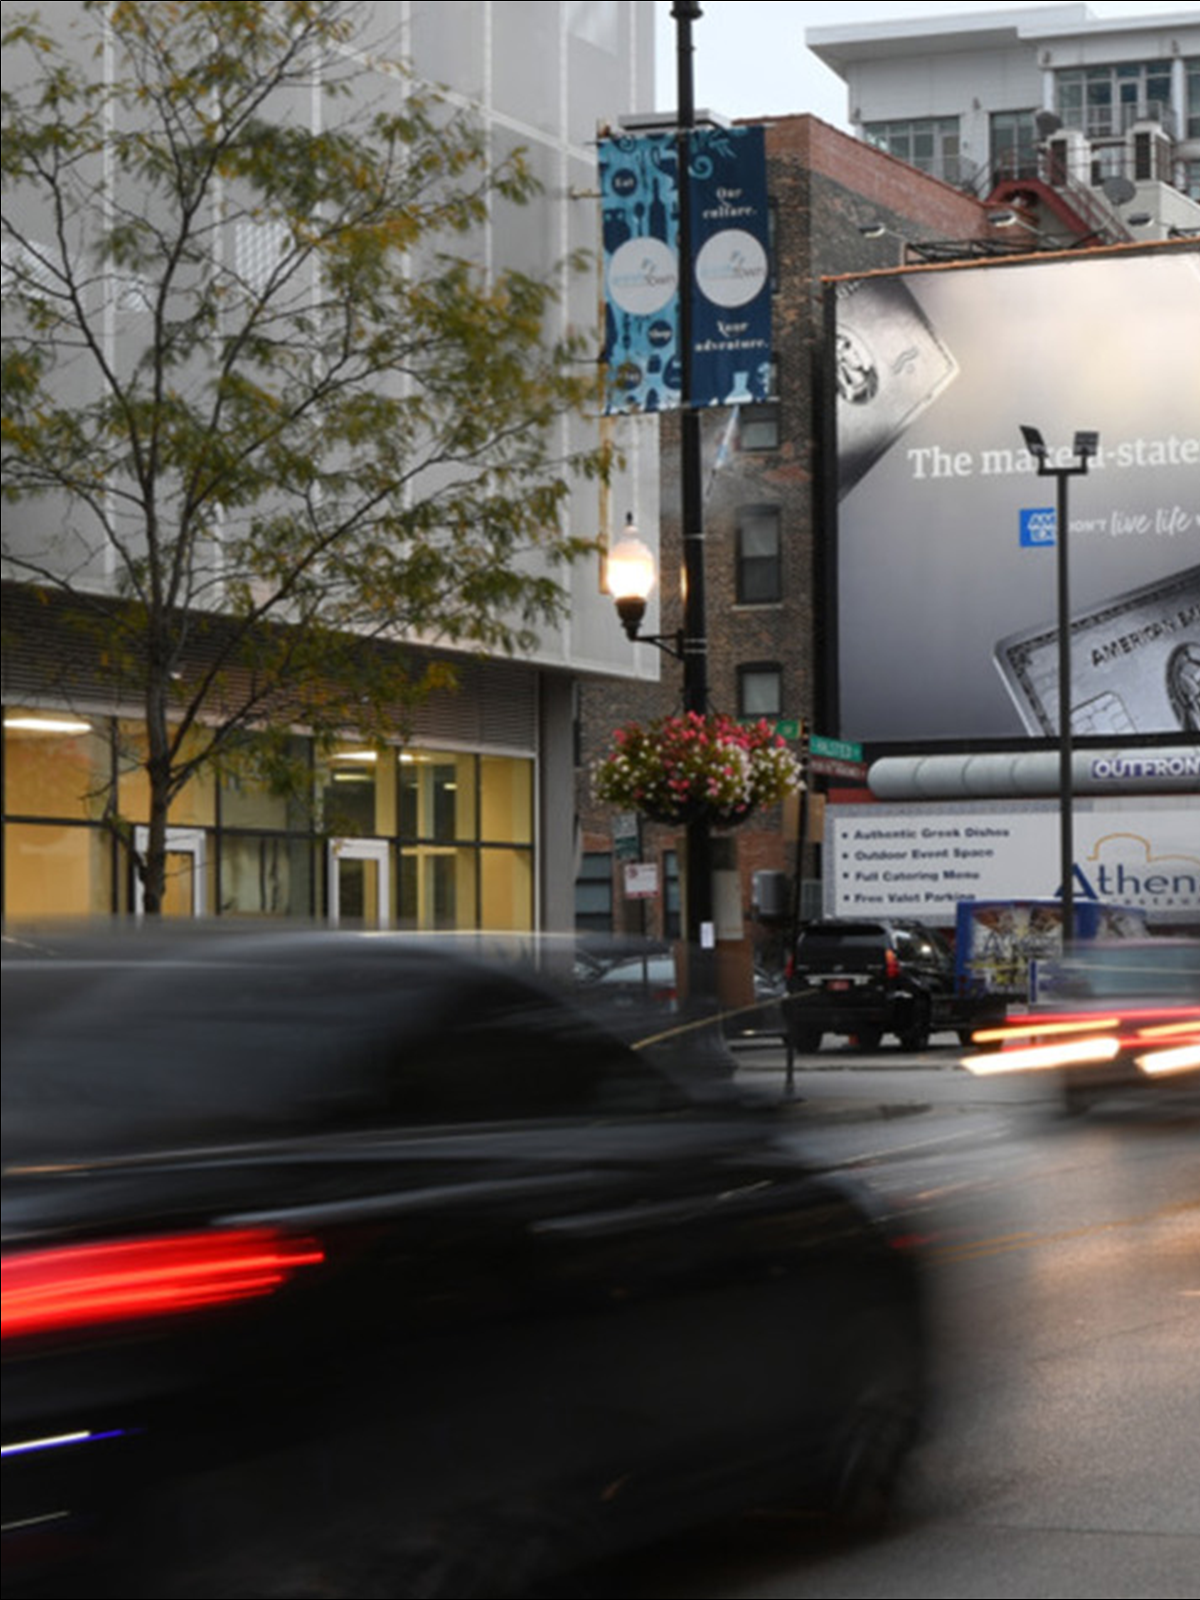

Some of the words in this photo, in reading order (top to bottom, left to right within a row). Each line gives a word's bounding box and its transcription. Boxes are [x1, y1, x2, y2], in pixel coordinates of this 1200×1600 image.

[908, 447, 973, 479] The
[1110, 511, 1150, 537] live
[1155, 507, 1192, 535] life
[1091, 618, 1176, 667] AMERICAN
[854, 829, 917, 840] Authentic
[921, 828, 960, 839] Greek
[964, 827, 1010, 838] Dishes
[855, 850, 908, 861] Outdoor
[912, 849, 949, 860] Event
[953, 848, 994, 860] Space
[855, 871, 878, 882] Full
[883, 870, 939, 883] Catering
[943, 869, 980, 881] Menu
[855, 893, 883, 904] Free
[888, 893, 921, 904] Valet
